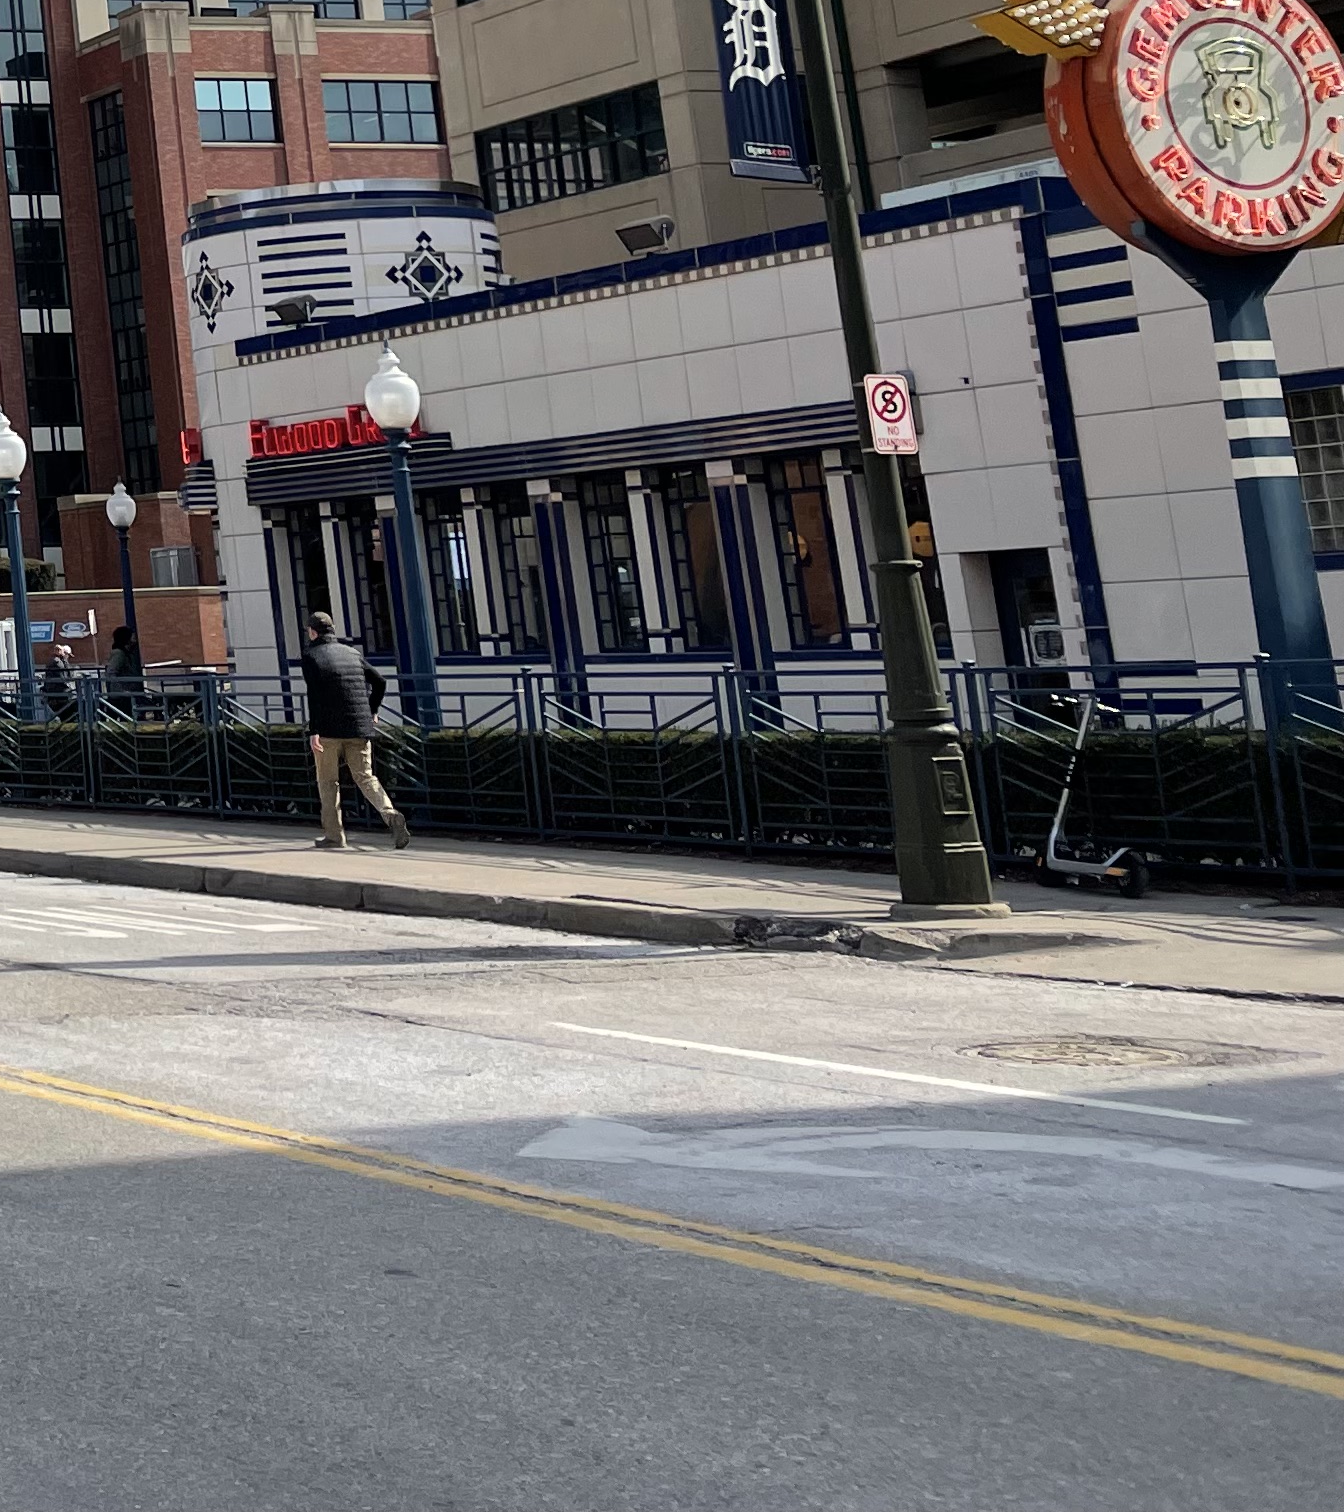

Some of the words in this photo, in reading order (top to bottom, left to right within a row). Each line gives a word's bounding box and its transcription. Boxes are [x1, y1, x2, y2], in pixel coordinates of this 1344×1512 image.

[1150, 143, 1344, 238] PARKING
[887, 426, 900, 435] NO
[877, 437, 915, 448] STANDING
